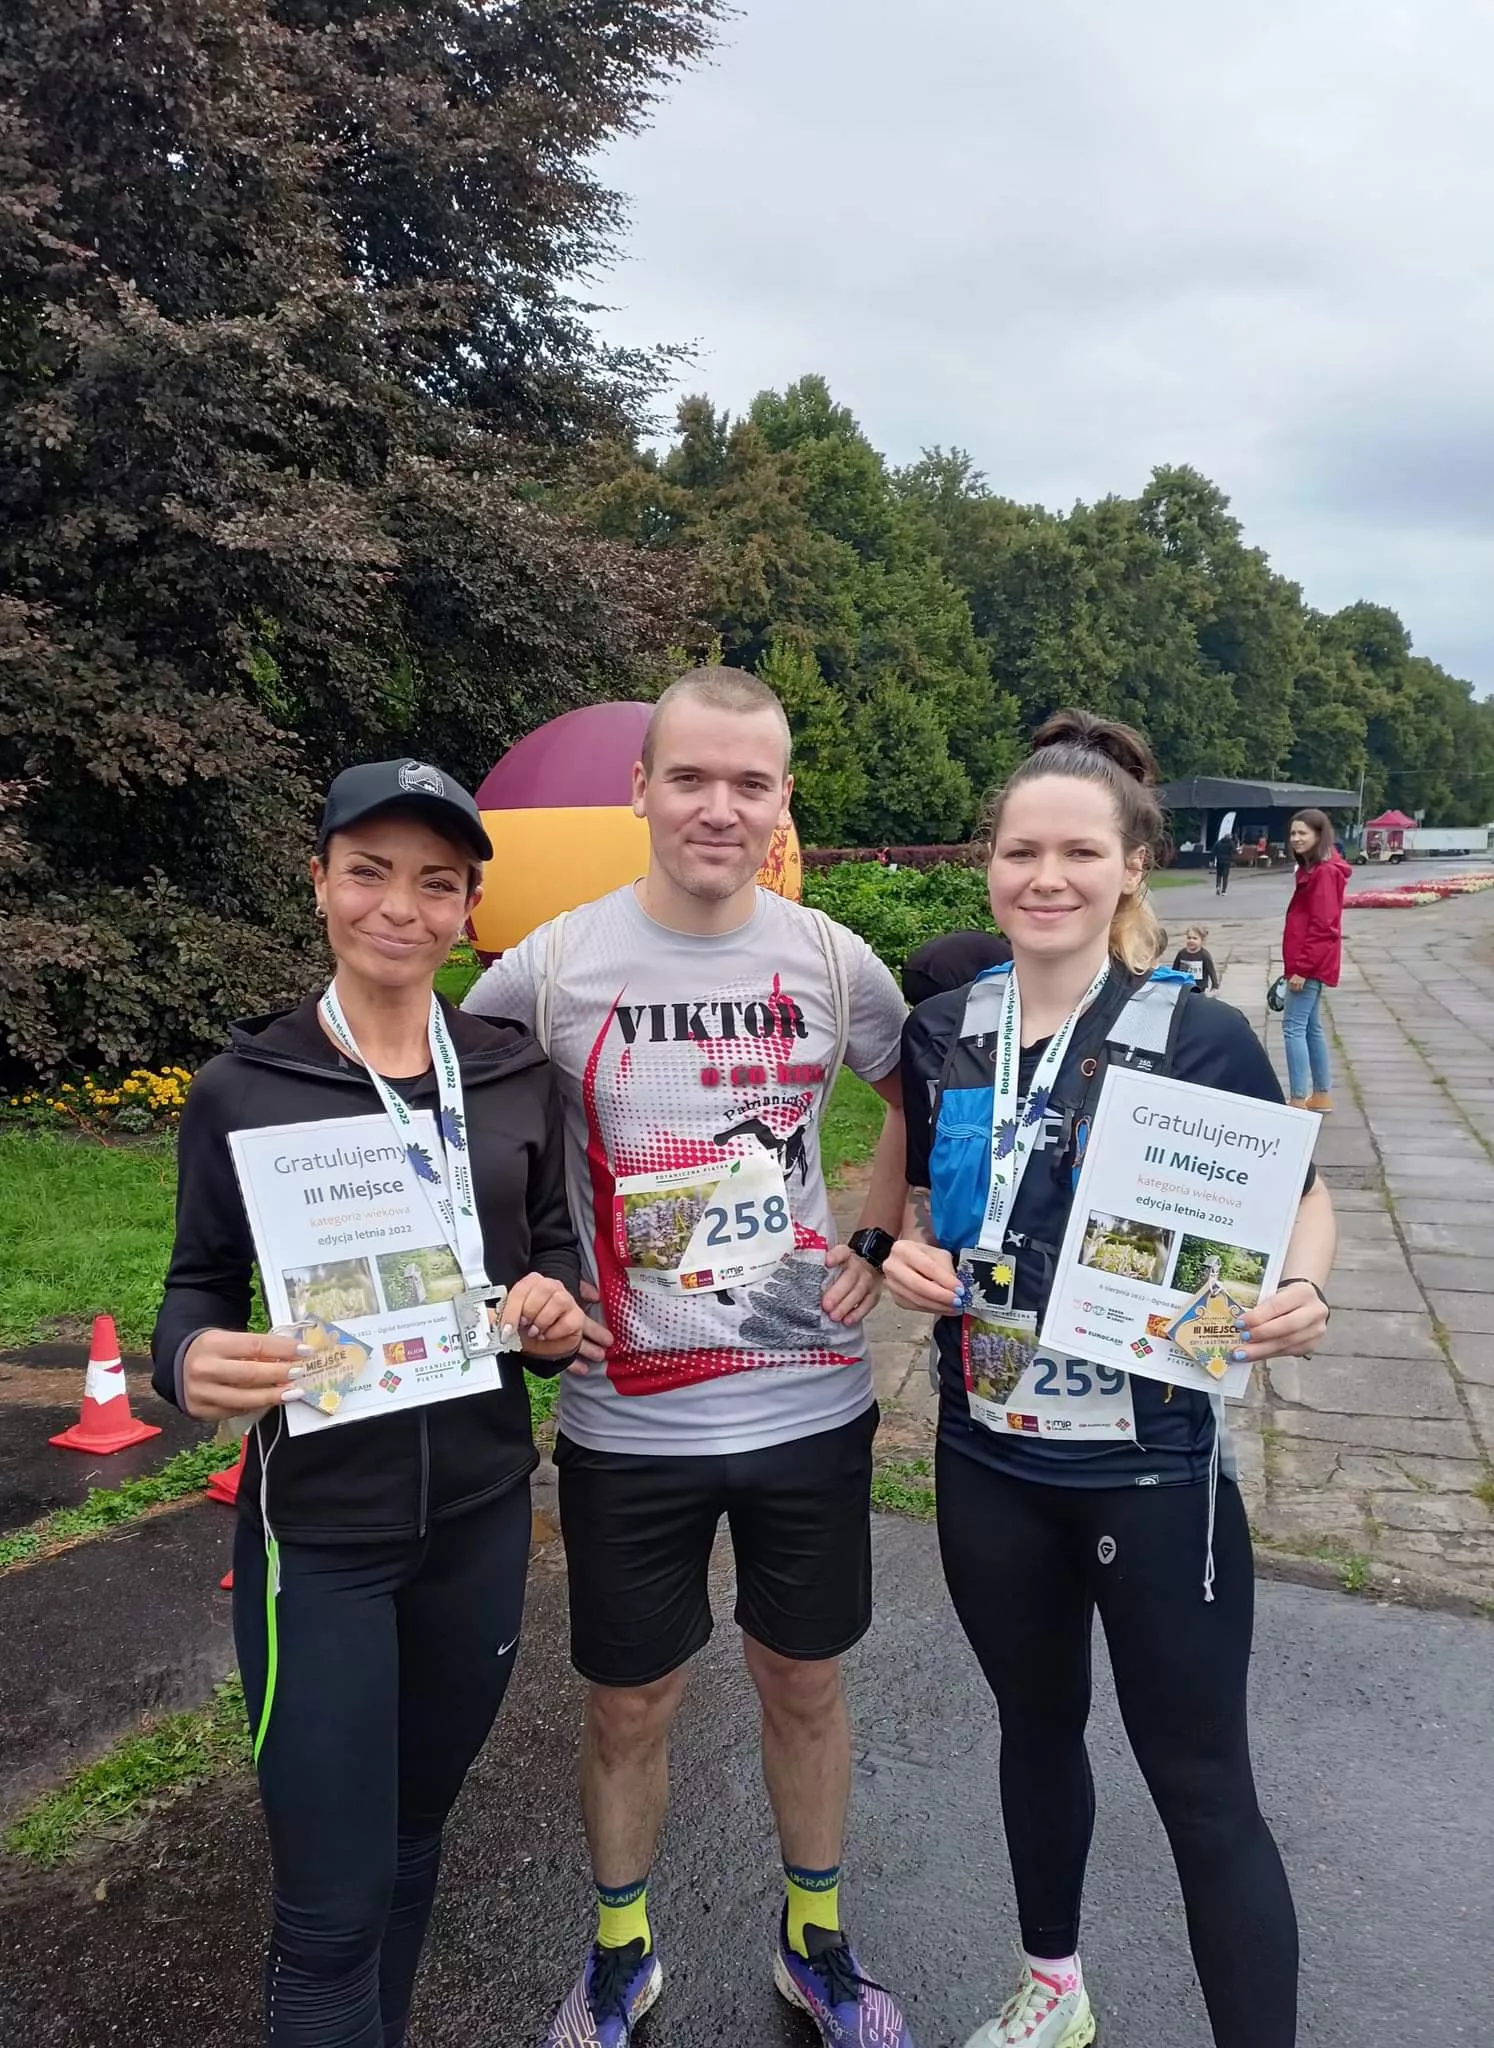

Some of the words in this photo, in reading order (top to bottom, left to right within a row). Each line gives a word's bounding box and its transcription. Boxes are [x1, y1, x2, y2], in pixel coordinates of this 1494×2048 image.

[614, 1001, 809, 1045] VIKTOR
[1003, 1016, 1014, 1040] Piątka
[439, 1043, 451, 1064] letnia
[444, 1065, 457, 1089] 2022
[1001, 1042, 1011, 1095] Botaniczna
[393, 1100, 411, 1126] 2022
[1131, 1105, 1281, 1160] Gratulujemy!
[1144, 1145, 1166, 1164] III
[1169, 1151, 1249, 1186] Miejsce
[303, 1187, 324, 1205] III
[330, 1178, 405, 1204] Miejsce
[1136, 1174, 1190, 1197] kategoria
[1191, 1188, 1243, 1209] wiekowa
[309, 1209, 362, 1230] kategoria
[363, 1204, 411, 1221] wiekowa
[704, 1195, 788, 1247] 258
[1135, 1193, 1172, 1213] edycja
[1174, 1202, 1206, 1221] letnia
[1207, 1212, 1235, 1227] 2022
[317, 1230, 354, 1247] edycja
[355, 1225, 387, 1242] letnia
[388, 1223, 413, 1236] 2022
[618, 1239, 626, 1259] Start
[1203, 1325, 1241, 1335] MIEJSCE
[306, 1350, 348, 1372] MIEJSCE
[1032, 1358, 1126, 1397] 259
